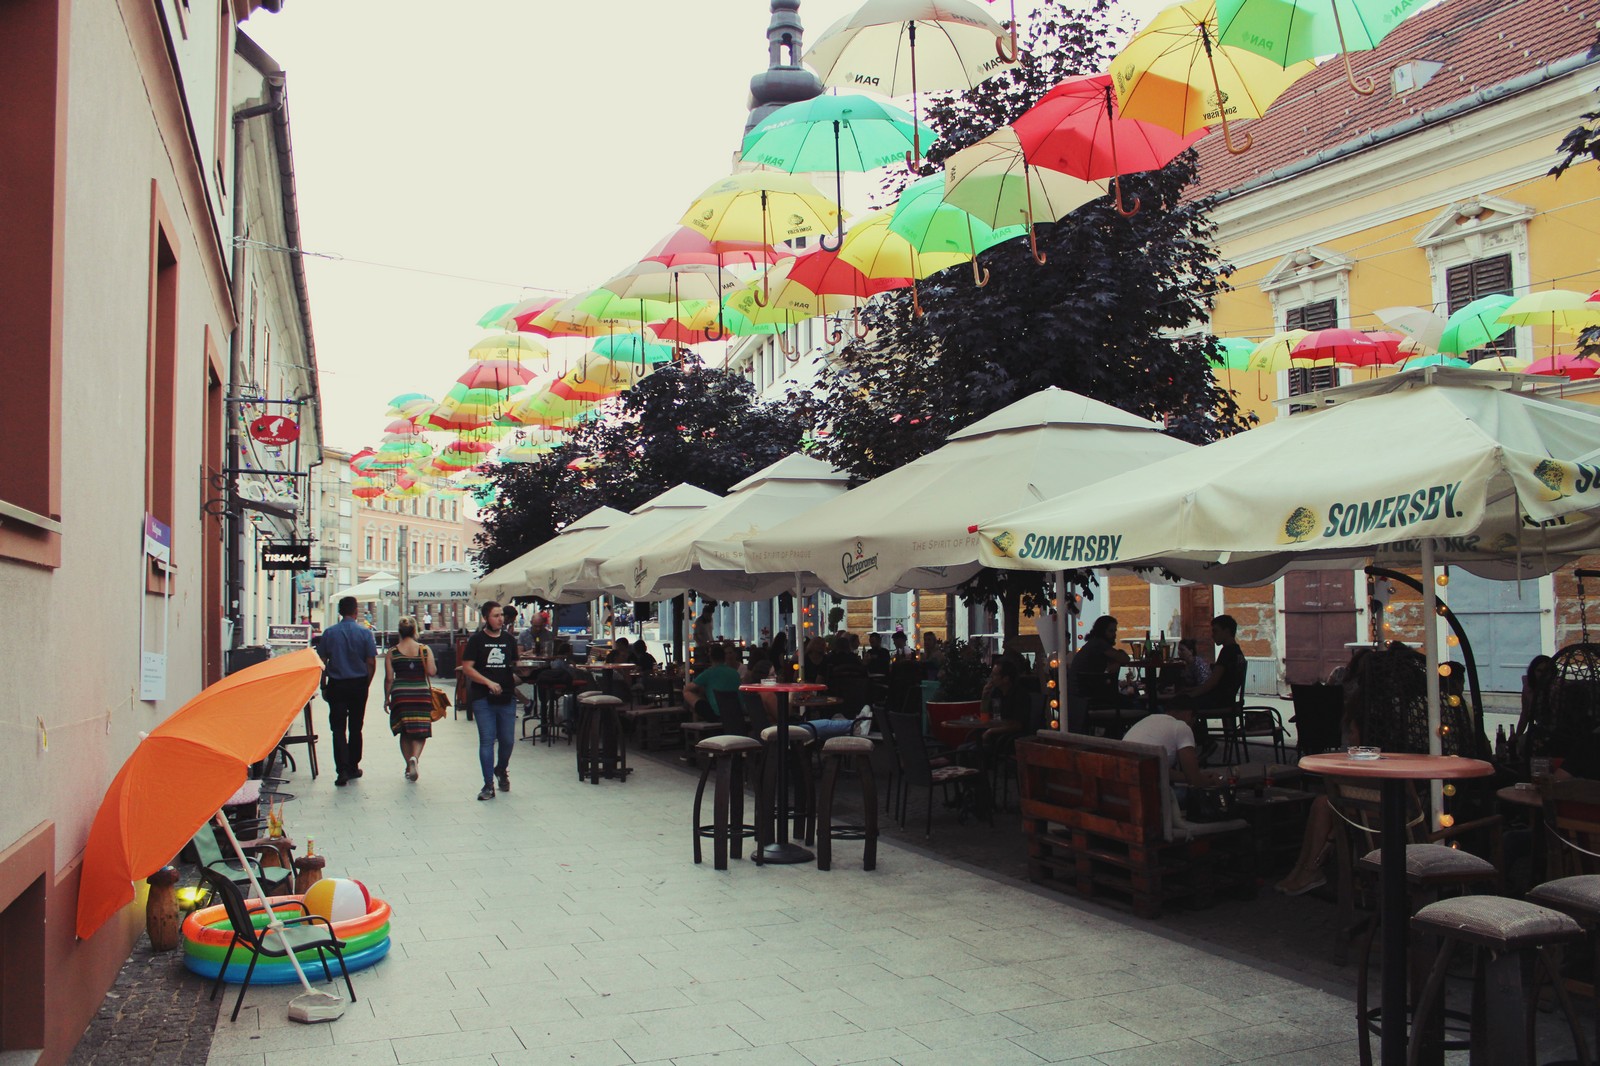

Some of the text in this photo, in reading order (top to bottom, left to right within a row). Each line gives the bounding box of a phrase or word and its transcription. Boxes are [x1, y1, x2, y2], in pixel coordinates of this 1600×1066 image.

[912, 541, 926, 551] THE
[928, 539, 951, 550] SPIRIT
[953, 538, 963, 548] OF
